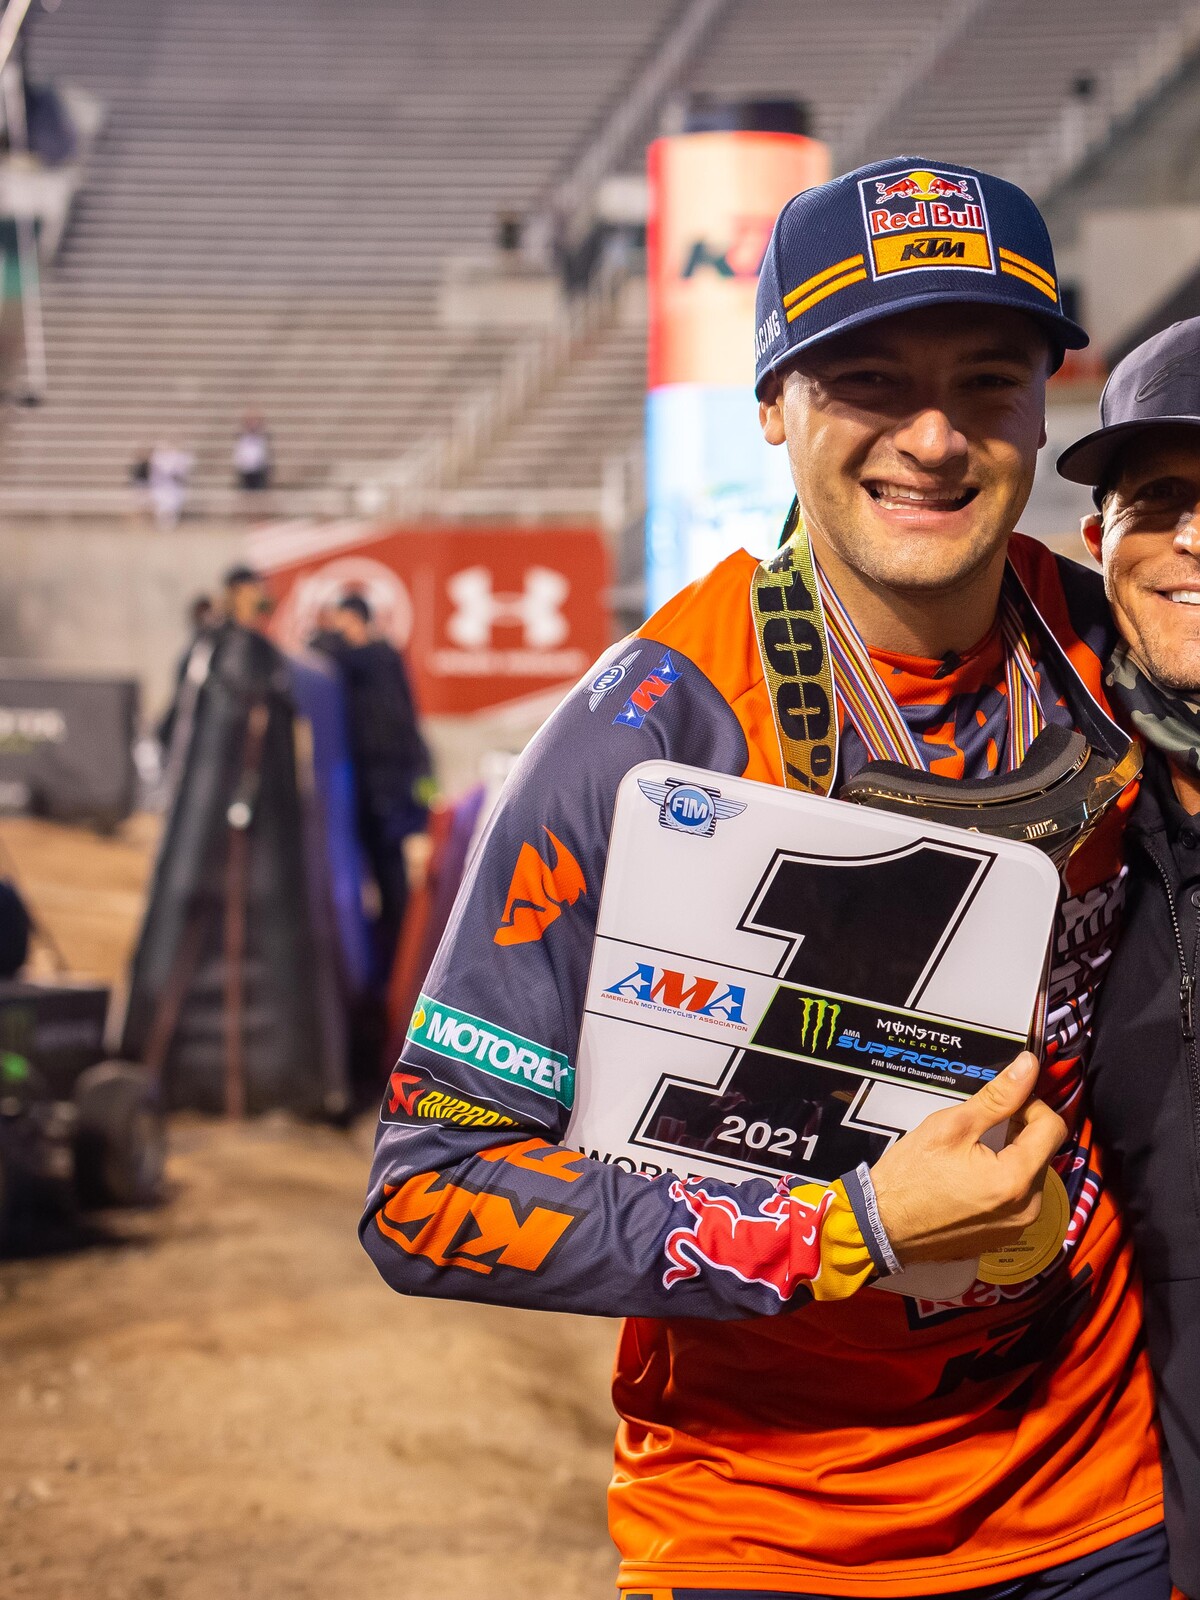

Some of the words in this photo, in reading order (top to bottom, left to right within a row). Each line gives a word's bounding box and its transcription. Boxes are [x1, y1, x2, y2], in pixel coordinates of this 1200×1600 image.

[870, 202, 928, 234] Red
[930, 202, 984, 230] Bull
[900, 238, 966, 262] KTM
[755, 309, 781, 362] ACING
[596, 668, 619, 690] FIM
[612, 649, 683, 729] AMA
[672, 797, 709, 819] FIM
[603, 962, 748, 1025] AMA
[600, 992, 640, 1006] AMERICAN
[640, 1002, 698, 1020] MOTORCYCLIST
[698, 1016, 749, 1032] ASSOCIATION
[842, 1028, 861, 1039] AMA
[877, 1018, 963, 1049] MONSTER
[888, 1035, 948, 1053] ENERGY
[426, 1011, 569, 1092] MOTOREX
[836, 1035, 999, 1081] SUPERCROSS
[871, 1058, 886, 1071] FIM
[886, 1061, 907, 1073] World
[907, 1066, 956, 1085] Championship
[717, 1115, 819, 1162] 2021
